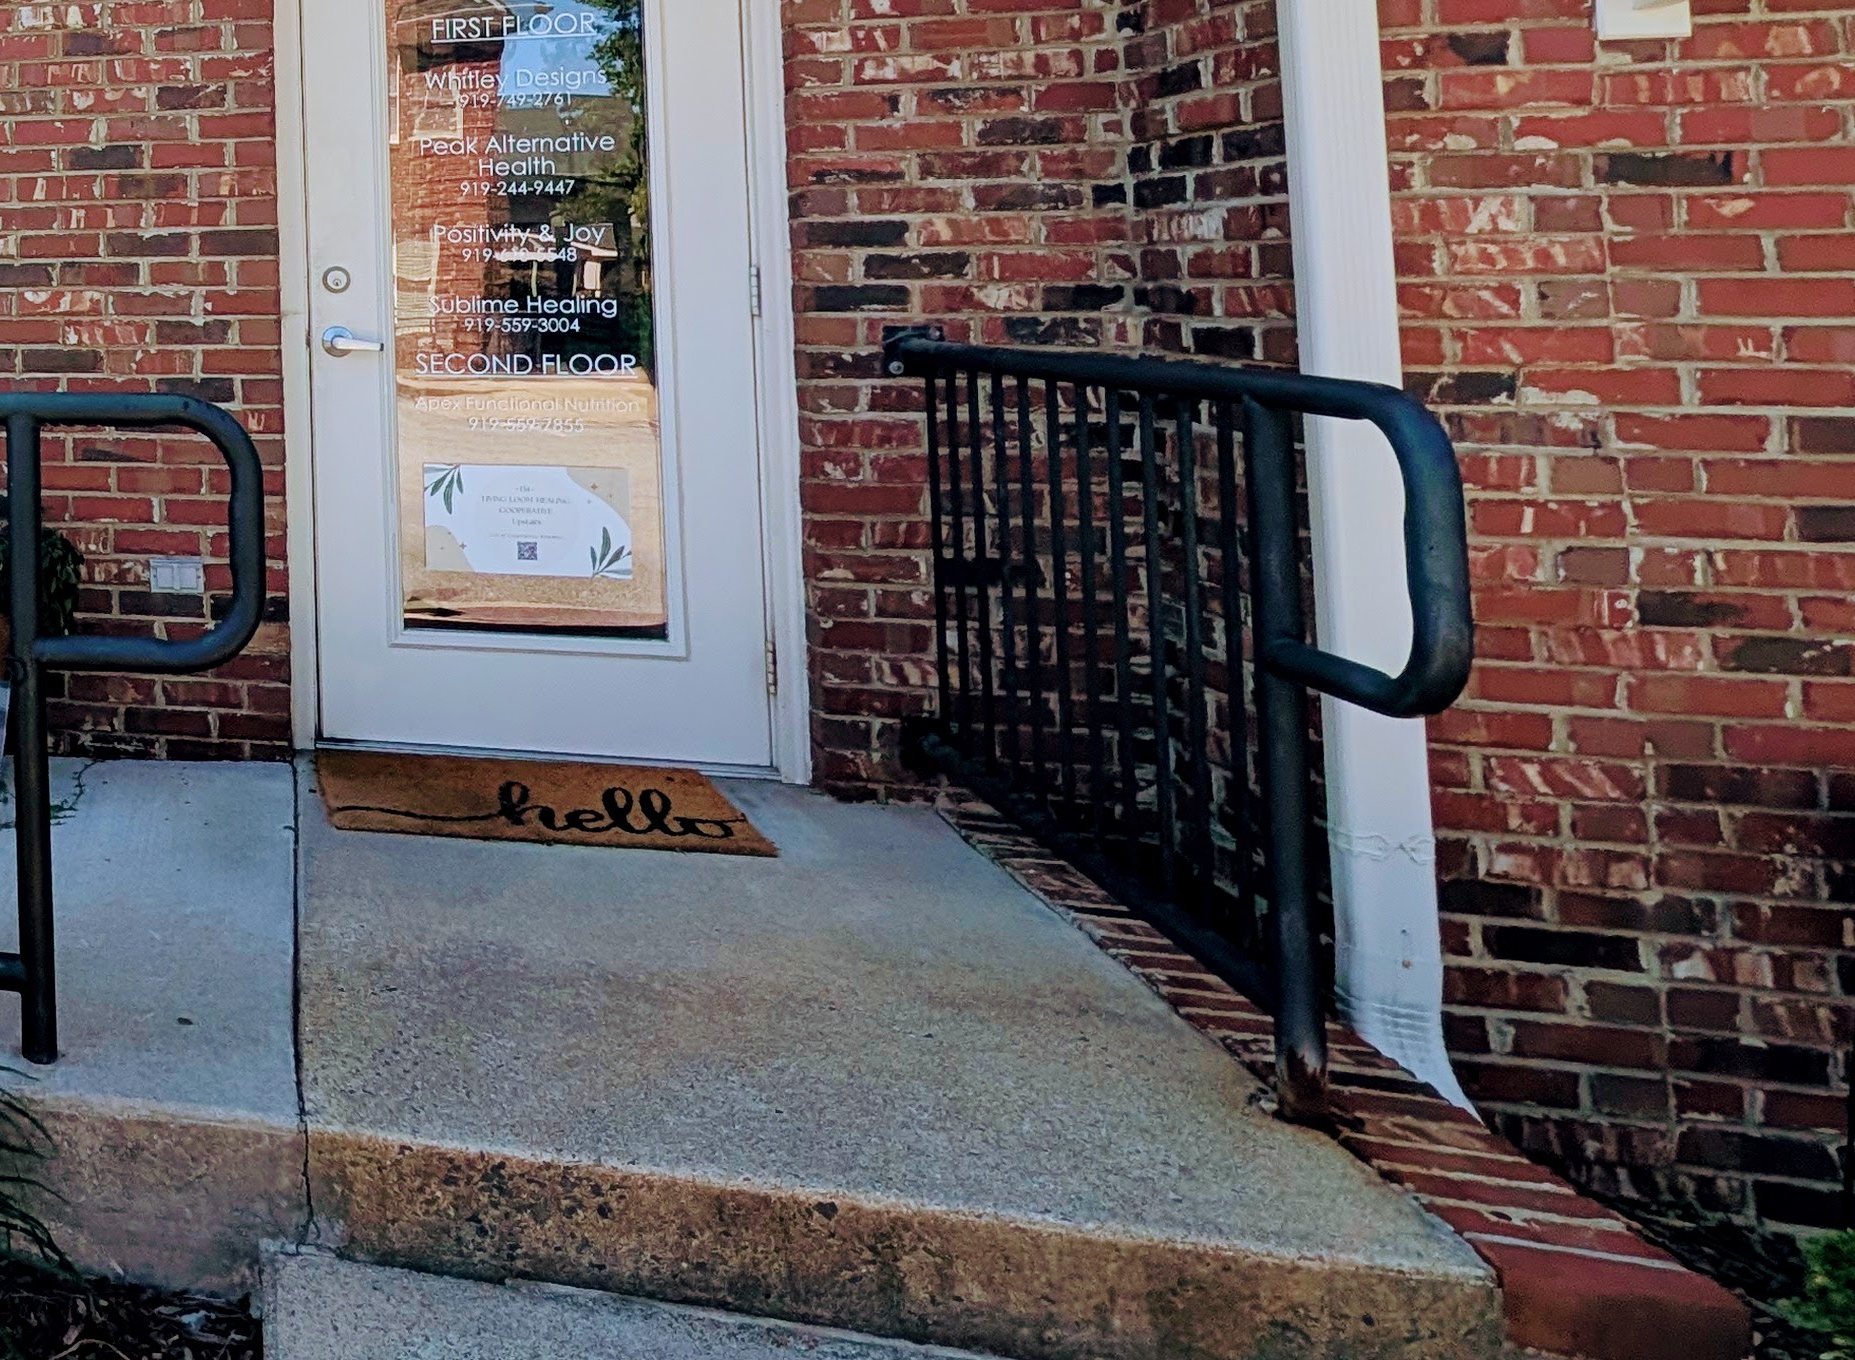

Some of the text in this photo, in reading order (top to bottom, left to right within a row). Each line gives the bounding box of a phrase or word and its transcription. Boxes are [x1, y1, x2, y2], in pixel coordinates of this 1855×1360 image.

[432, 12, 597, 40] FIRST FLOOR
[425, 66, 608, 92] Whitley Designs
[459, 92, 572, 109] 919-749-2761
[420, 133, 616, 156] Peak Alternative
[479, 156, 556, 177] Health
[460, 179, 576, 196] 919-244-9447
[434, 223, 606, 245] Positivity & Joy
[429, 295, 618, 319] Sublime Healing
[464, 317, 581, 333] 919-559-3004
[415, 353, 637, 375] SECOND FLOOR
[415, 396, 641, 413] Apex Functional Nutrition
[498, 781, 747, 838] hello
